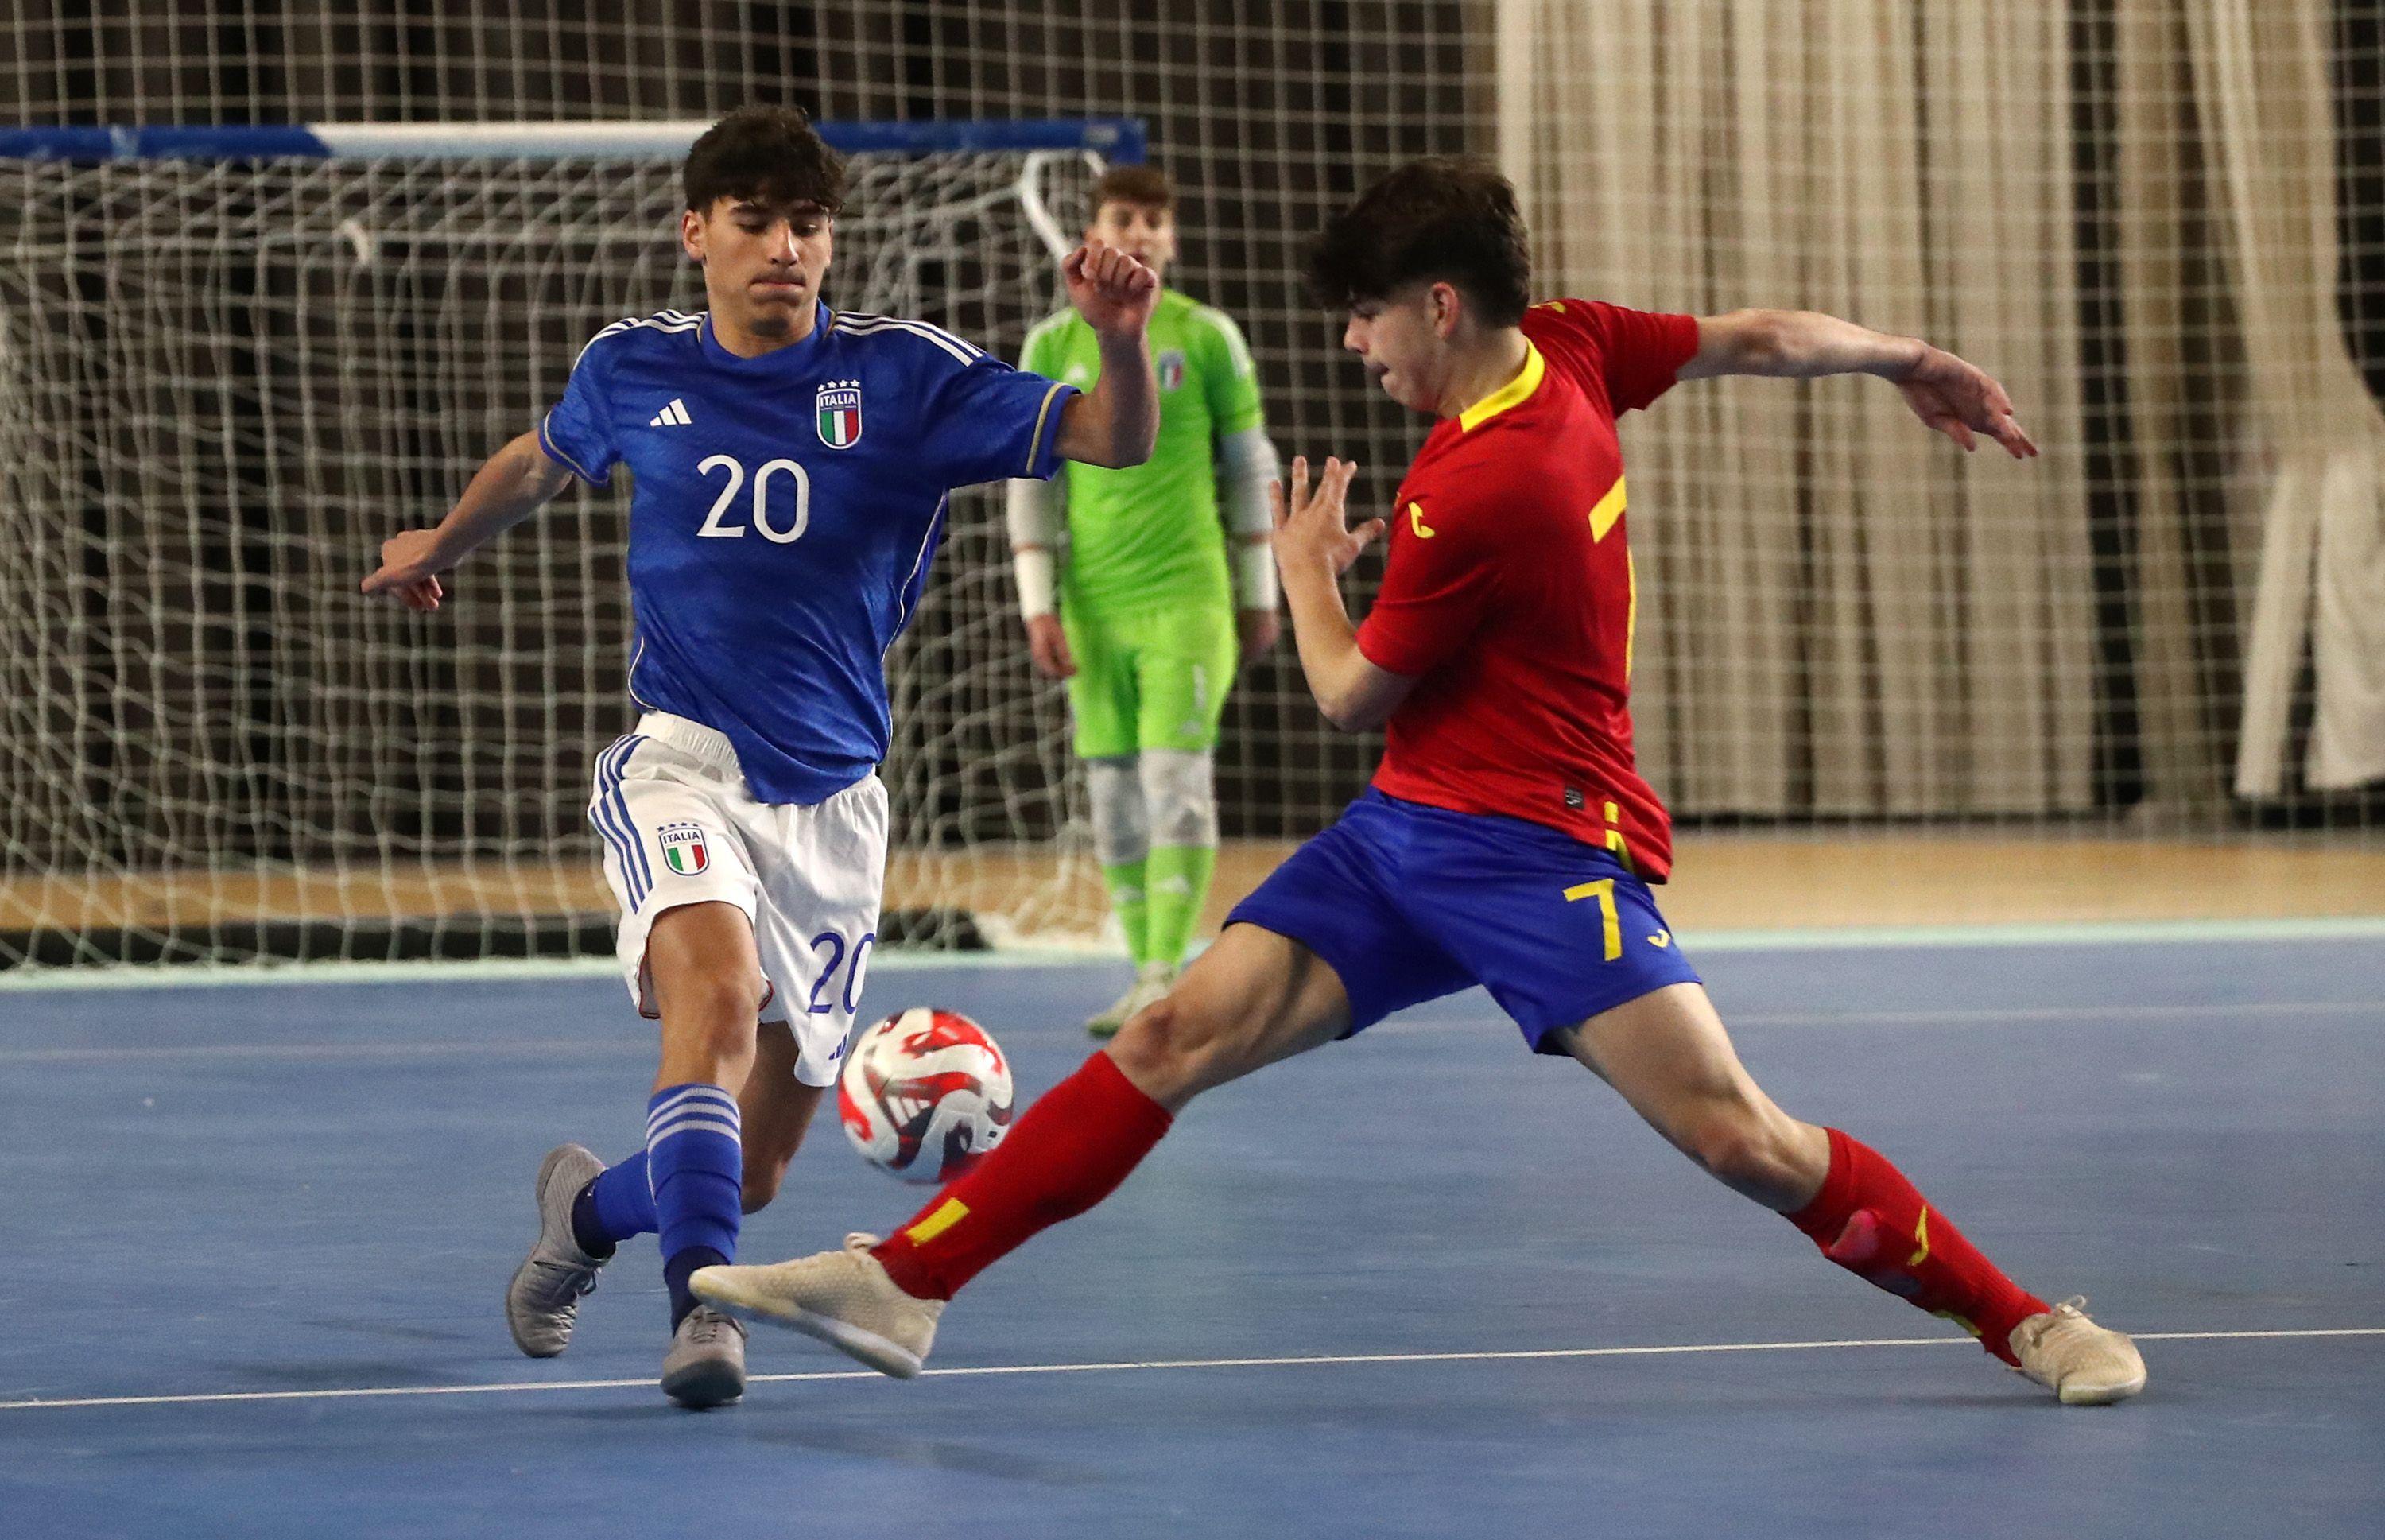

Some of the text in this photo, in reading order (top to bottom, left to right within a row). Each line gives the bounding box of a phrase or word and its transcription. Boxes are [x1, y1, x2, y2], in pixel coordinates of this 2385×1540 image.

[820, 393, 856, 407] ITALIA
[696, 454, 809, 543] 20
[663, 831, 700, 844] ITALIA
[1563, 878, 1622, 961] 7
